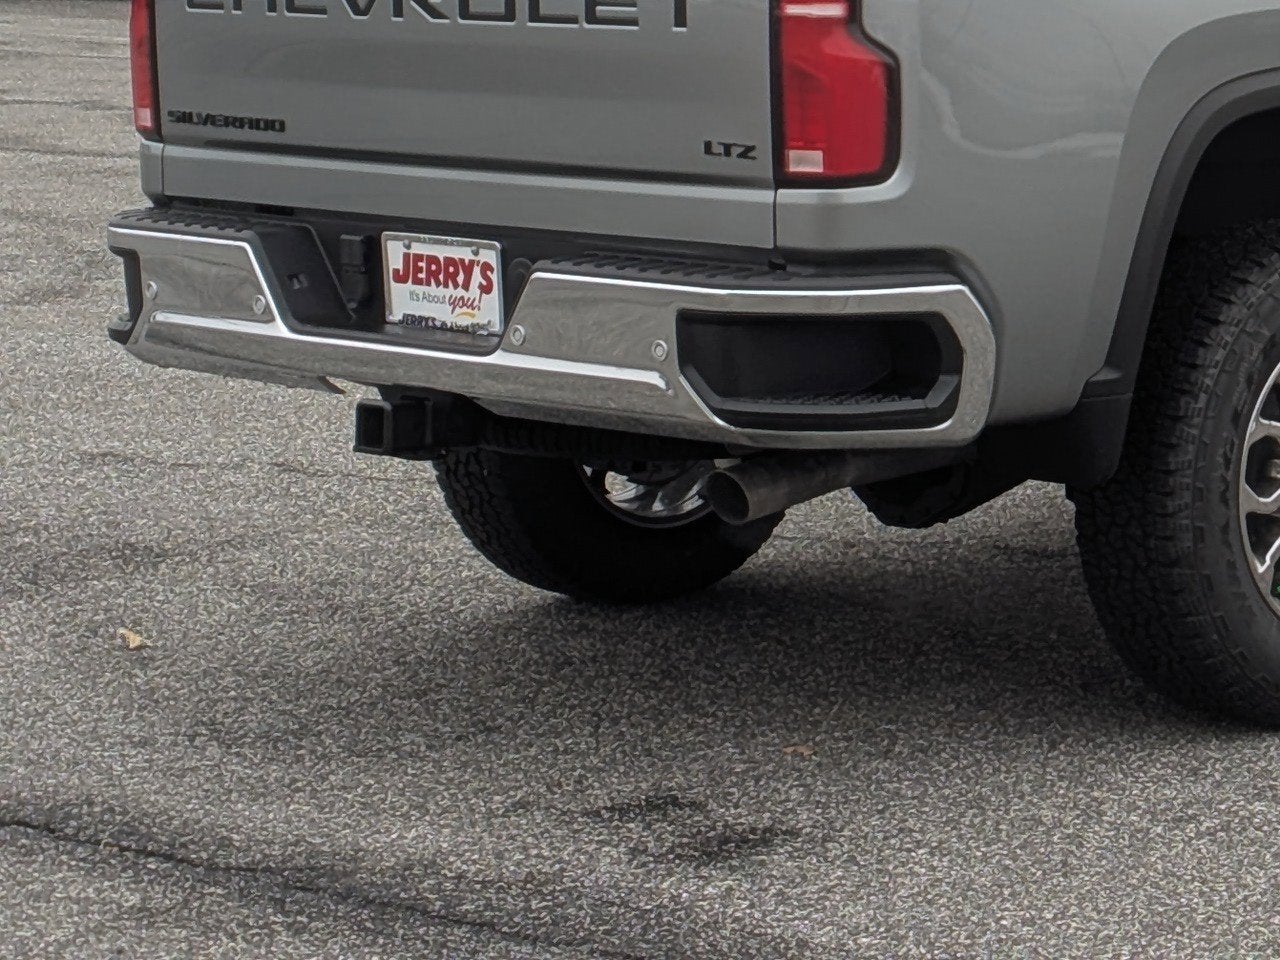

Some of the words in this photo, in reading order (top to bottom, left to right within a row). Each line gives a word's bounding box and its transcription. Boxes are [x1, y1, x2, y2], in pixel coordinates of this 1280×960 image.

[167, 109, 286, 133] SILVERADO
[704, 140, 757, 160] LTZ
[391, 251, 495, 296] JERRY'S
[409, 290, 421, 302] It's
[421, 290, 447, 306] About
[447, 290, 482, 315] you!
